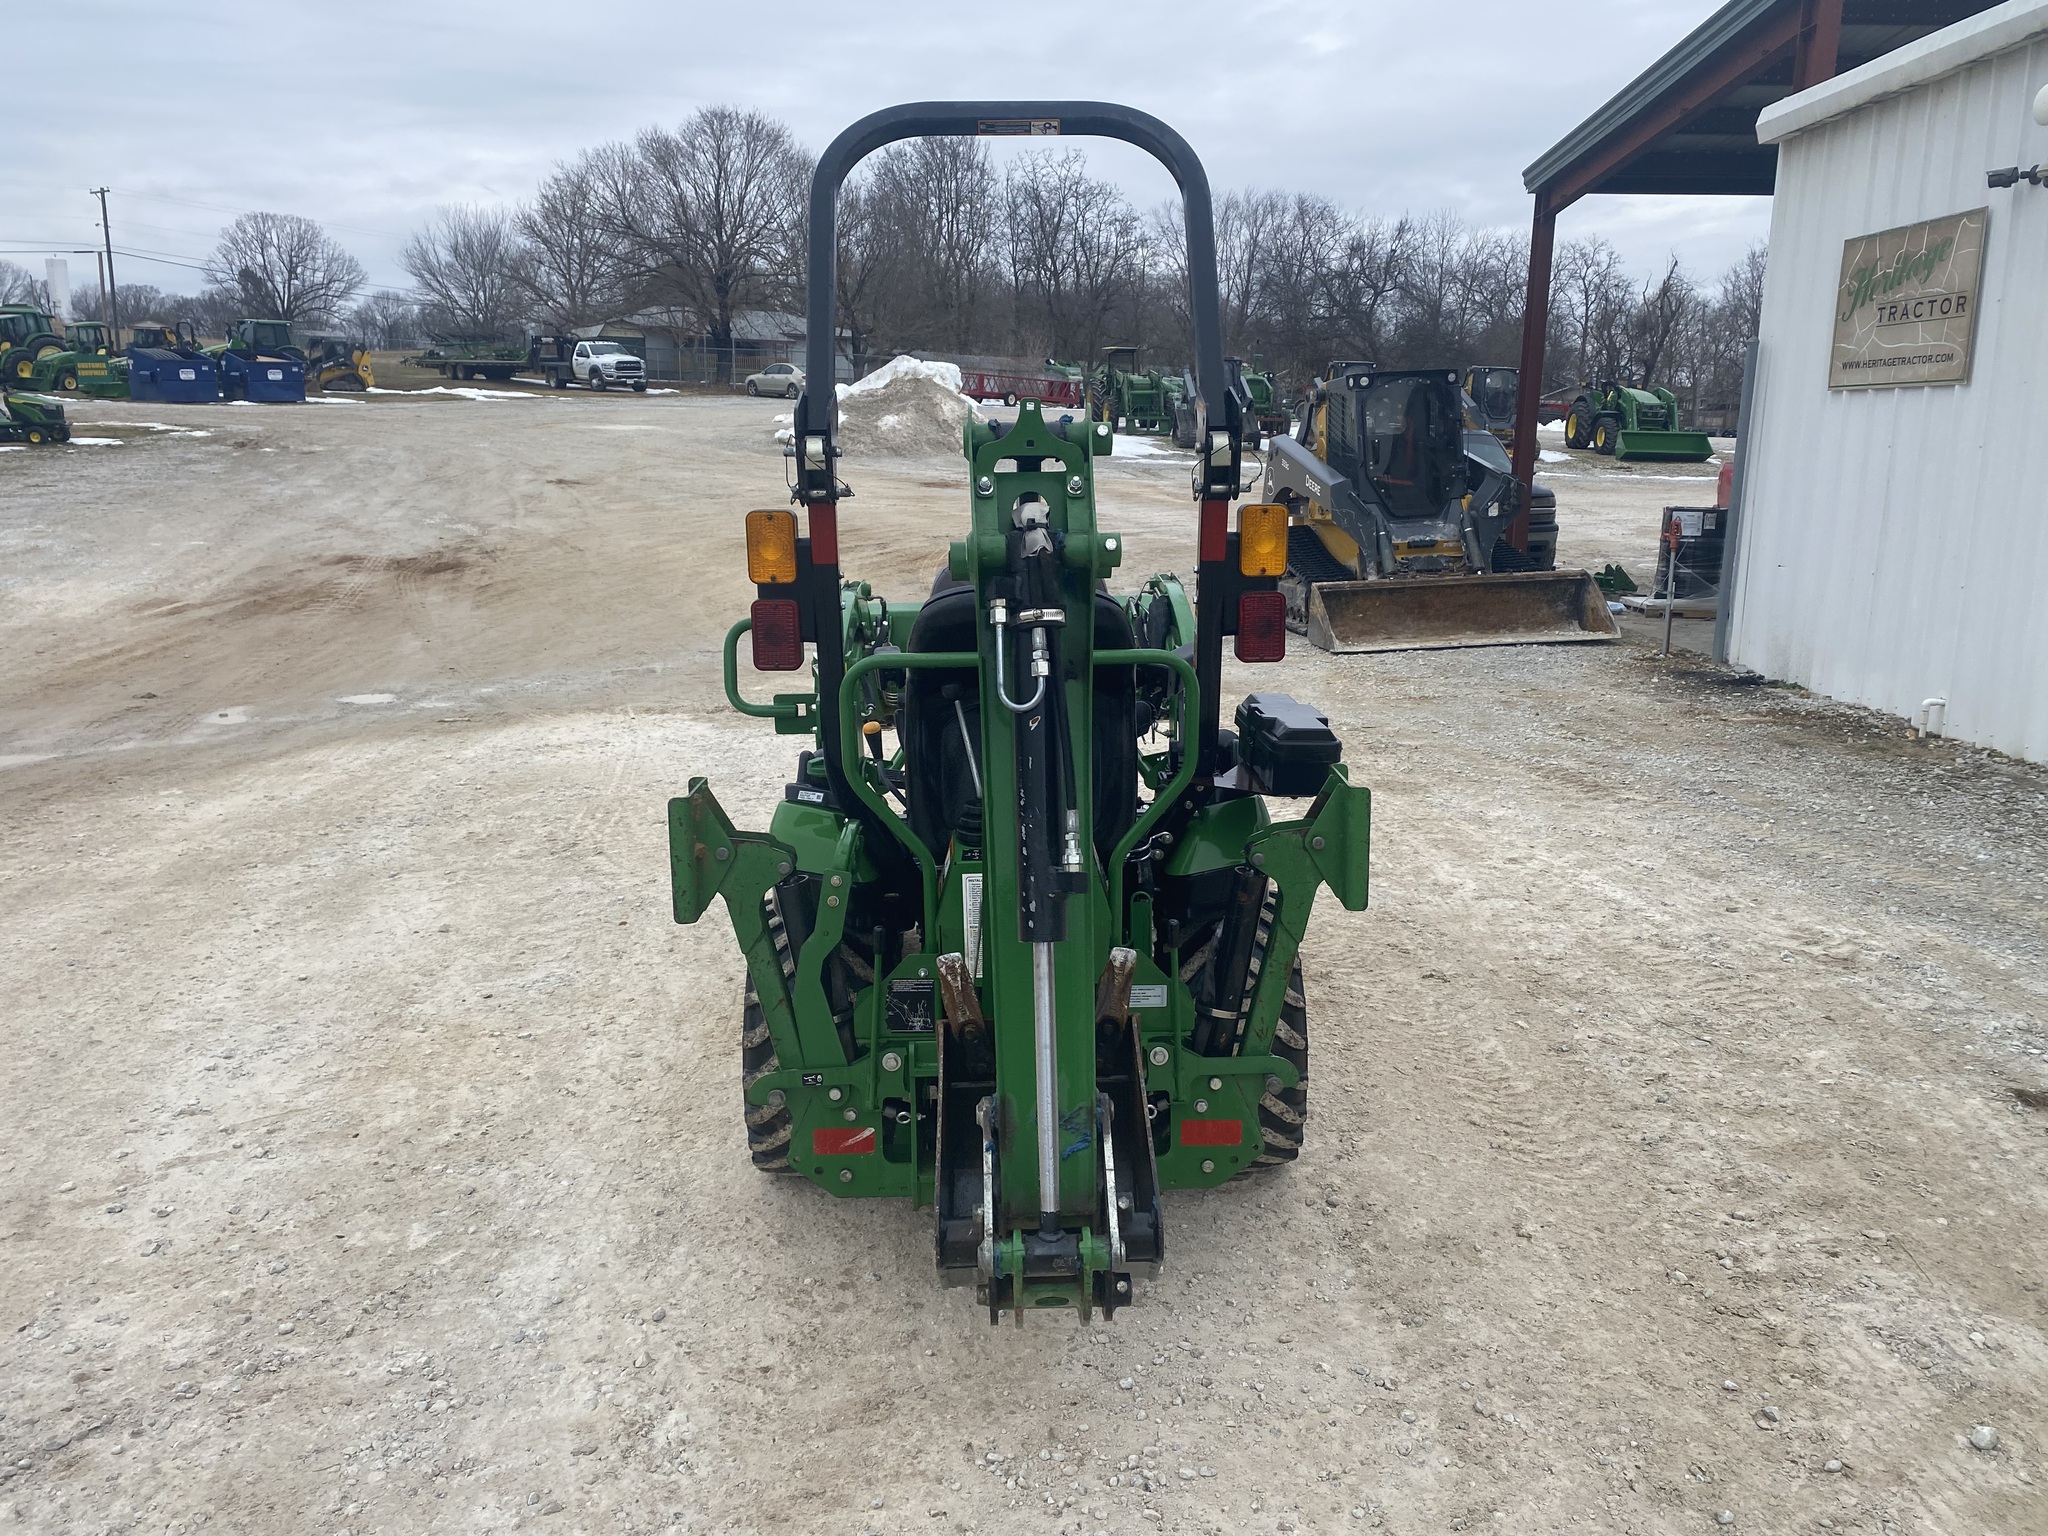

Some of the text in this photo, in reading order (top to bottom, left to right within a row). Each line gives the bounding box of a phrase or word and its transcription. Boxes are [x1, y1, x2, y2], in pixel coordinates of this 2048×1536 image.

[1842, 236, 1953, 322] Heritage
[1877, 296, 1967, 323] TRACTOR
[1842, 353, 1954, 369] WWW.HERITAGETRACTOR.COM
[1305, 474, 1321, 497] DEERE
